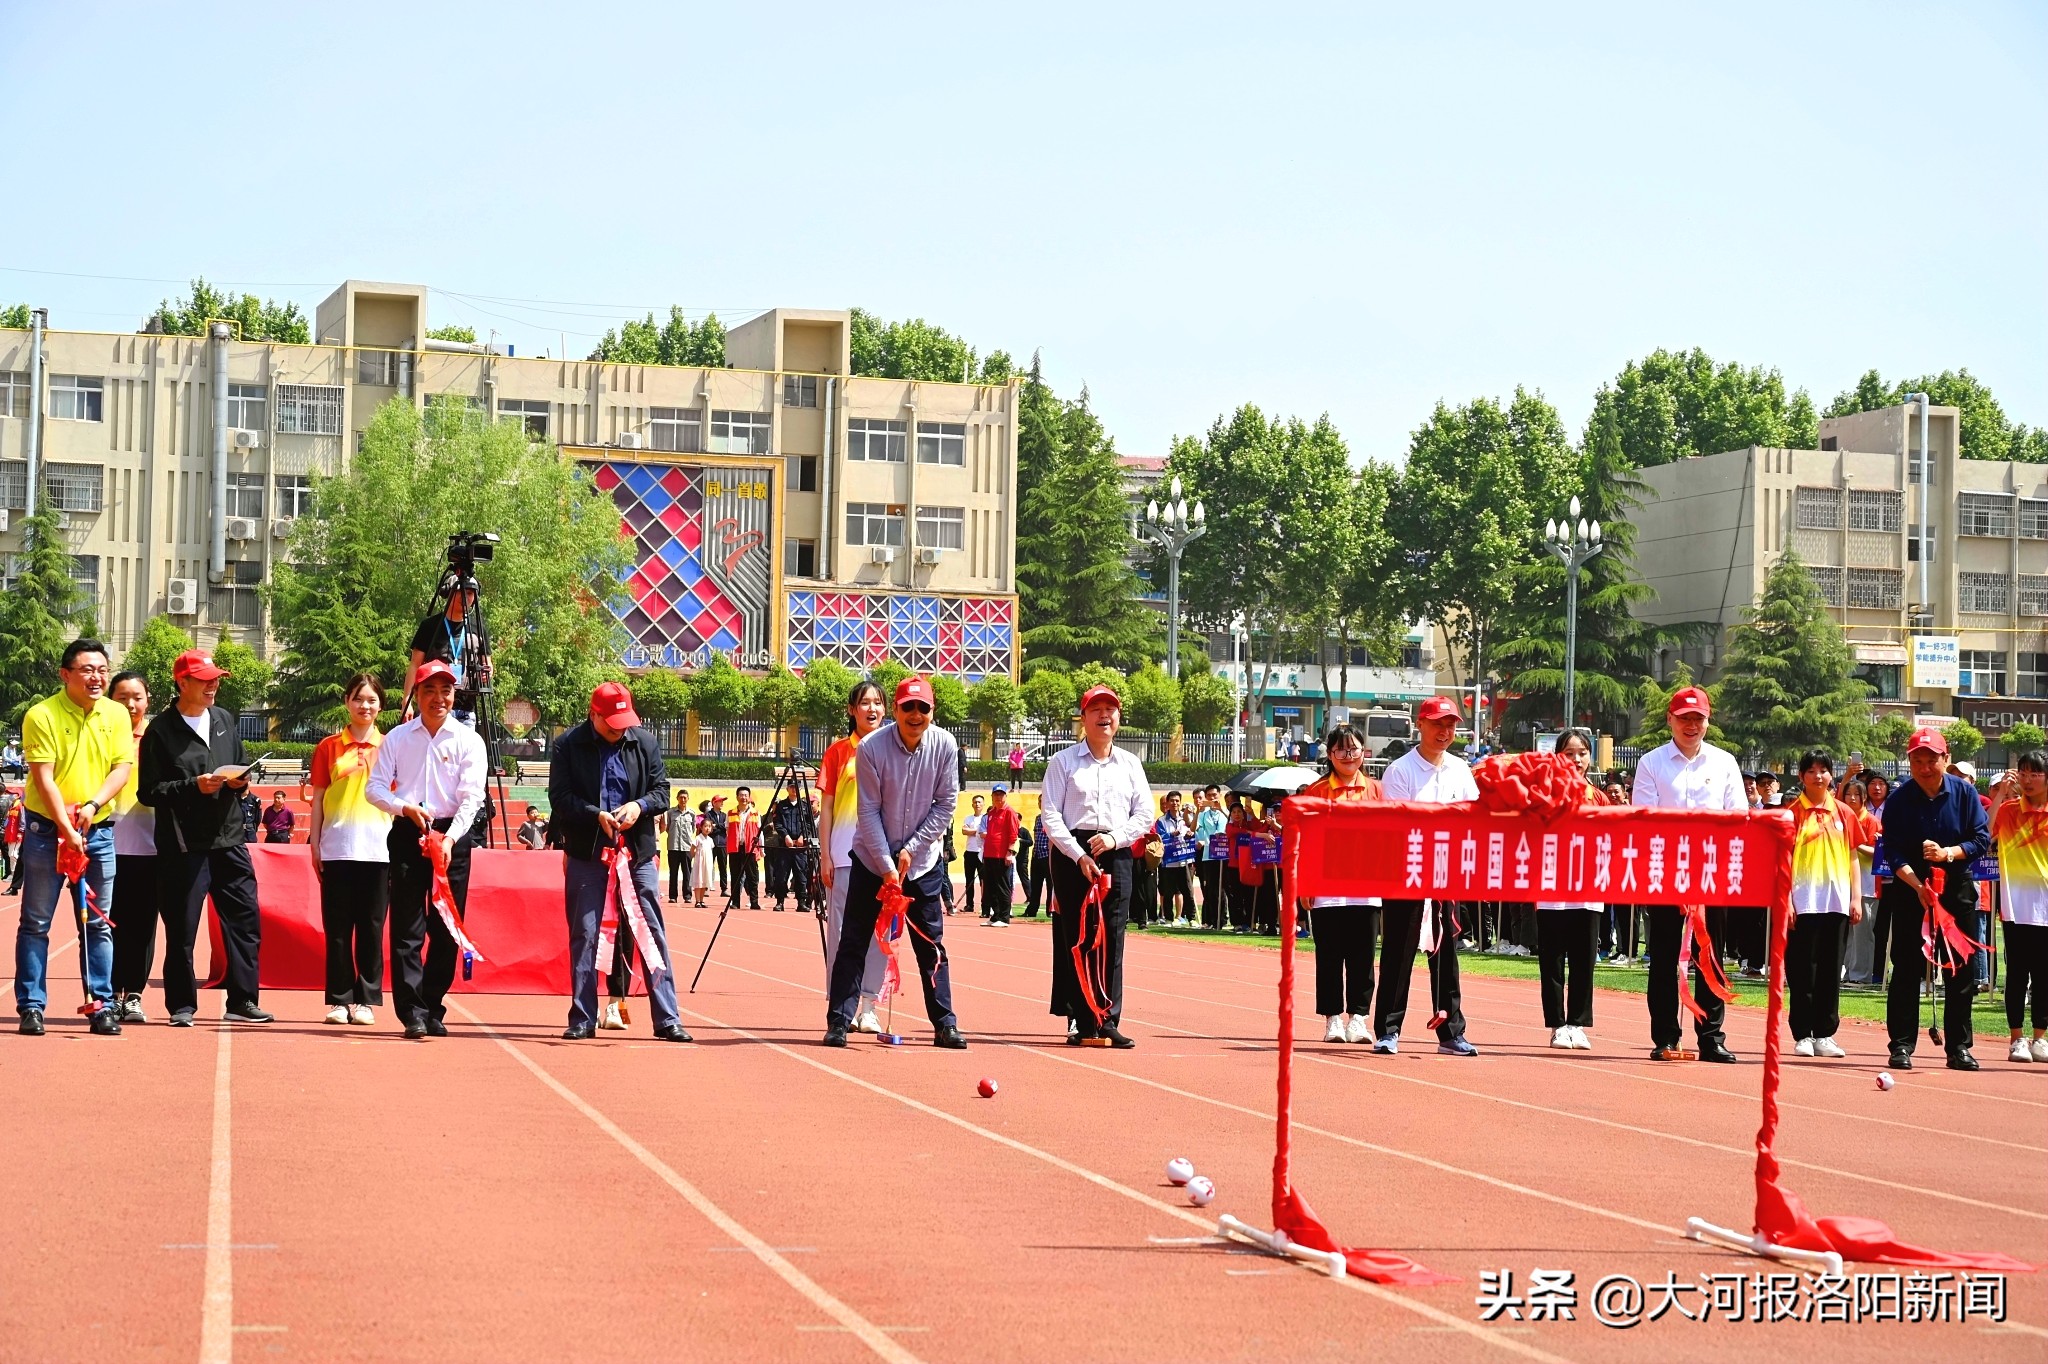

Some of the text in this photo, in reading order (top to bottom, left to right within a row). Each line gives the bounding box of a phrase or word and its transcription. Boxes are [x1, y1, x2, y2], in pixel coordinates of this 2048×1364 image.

[706, 480, 767, 500] 同一首歌
[1406, 829, 1745, 894] 美丽中国全国门球大赛总决赛
